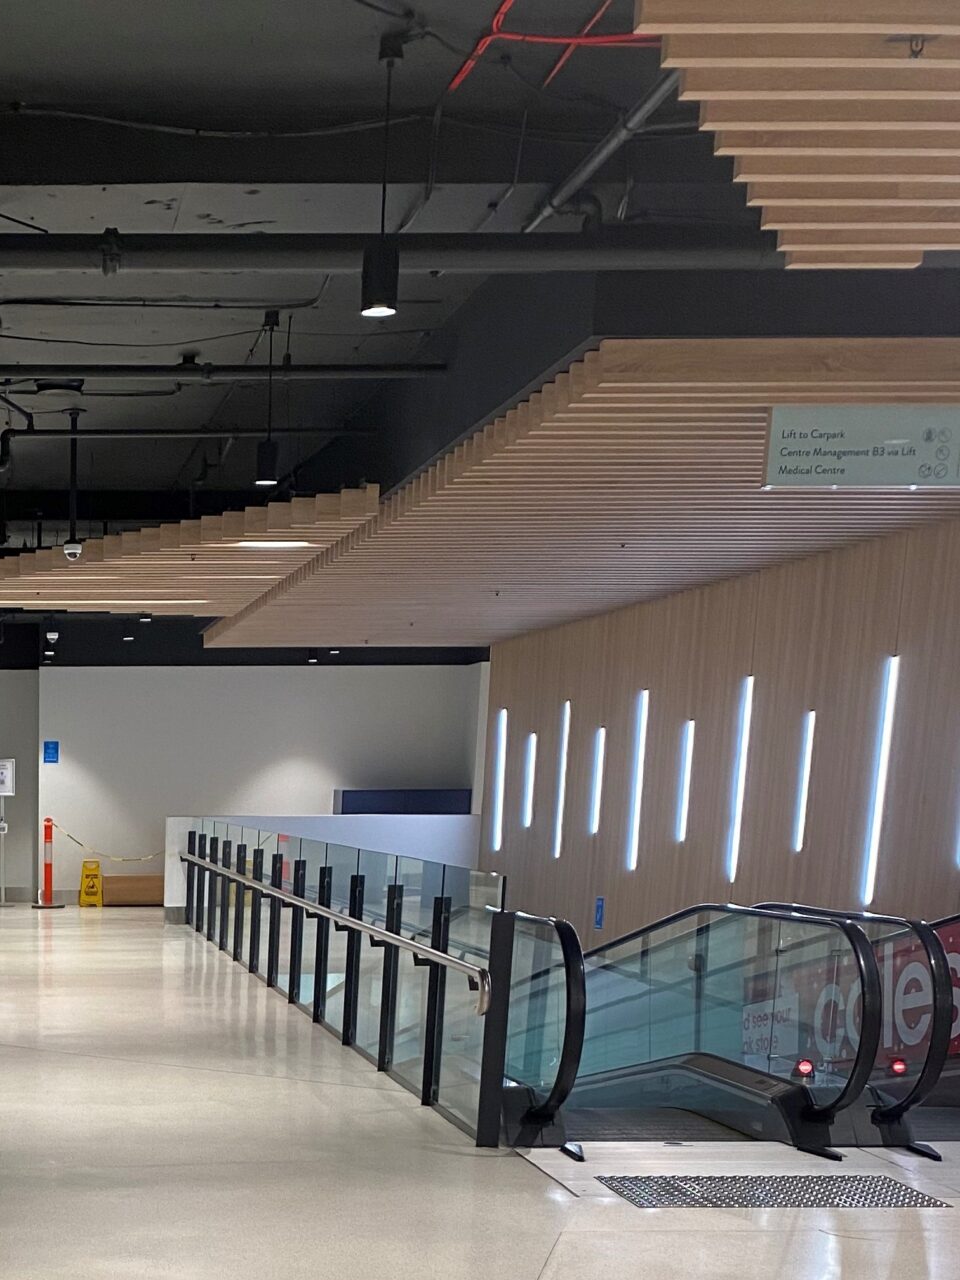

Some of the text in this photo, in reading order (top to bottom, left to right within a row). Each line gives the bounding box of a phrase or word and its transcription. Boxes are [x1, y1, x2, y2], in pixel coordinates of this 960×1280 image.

[781, 429, 846, 442] Lift to Carpark
[780, 447, 811, 457] Centre
[812, 447, 870, 460] Management
[901, 446, 916, 456] Lift
[778, 464, 846, 475] Medical Centre
[755, 1033, 779, 1051] stoe
